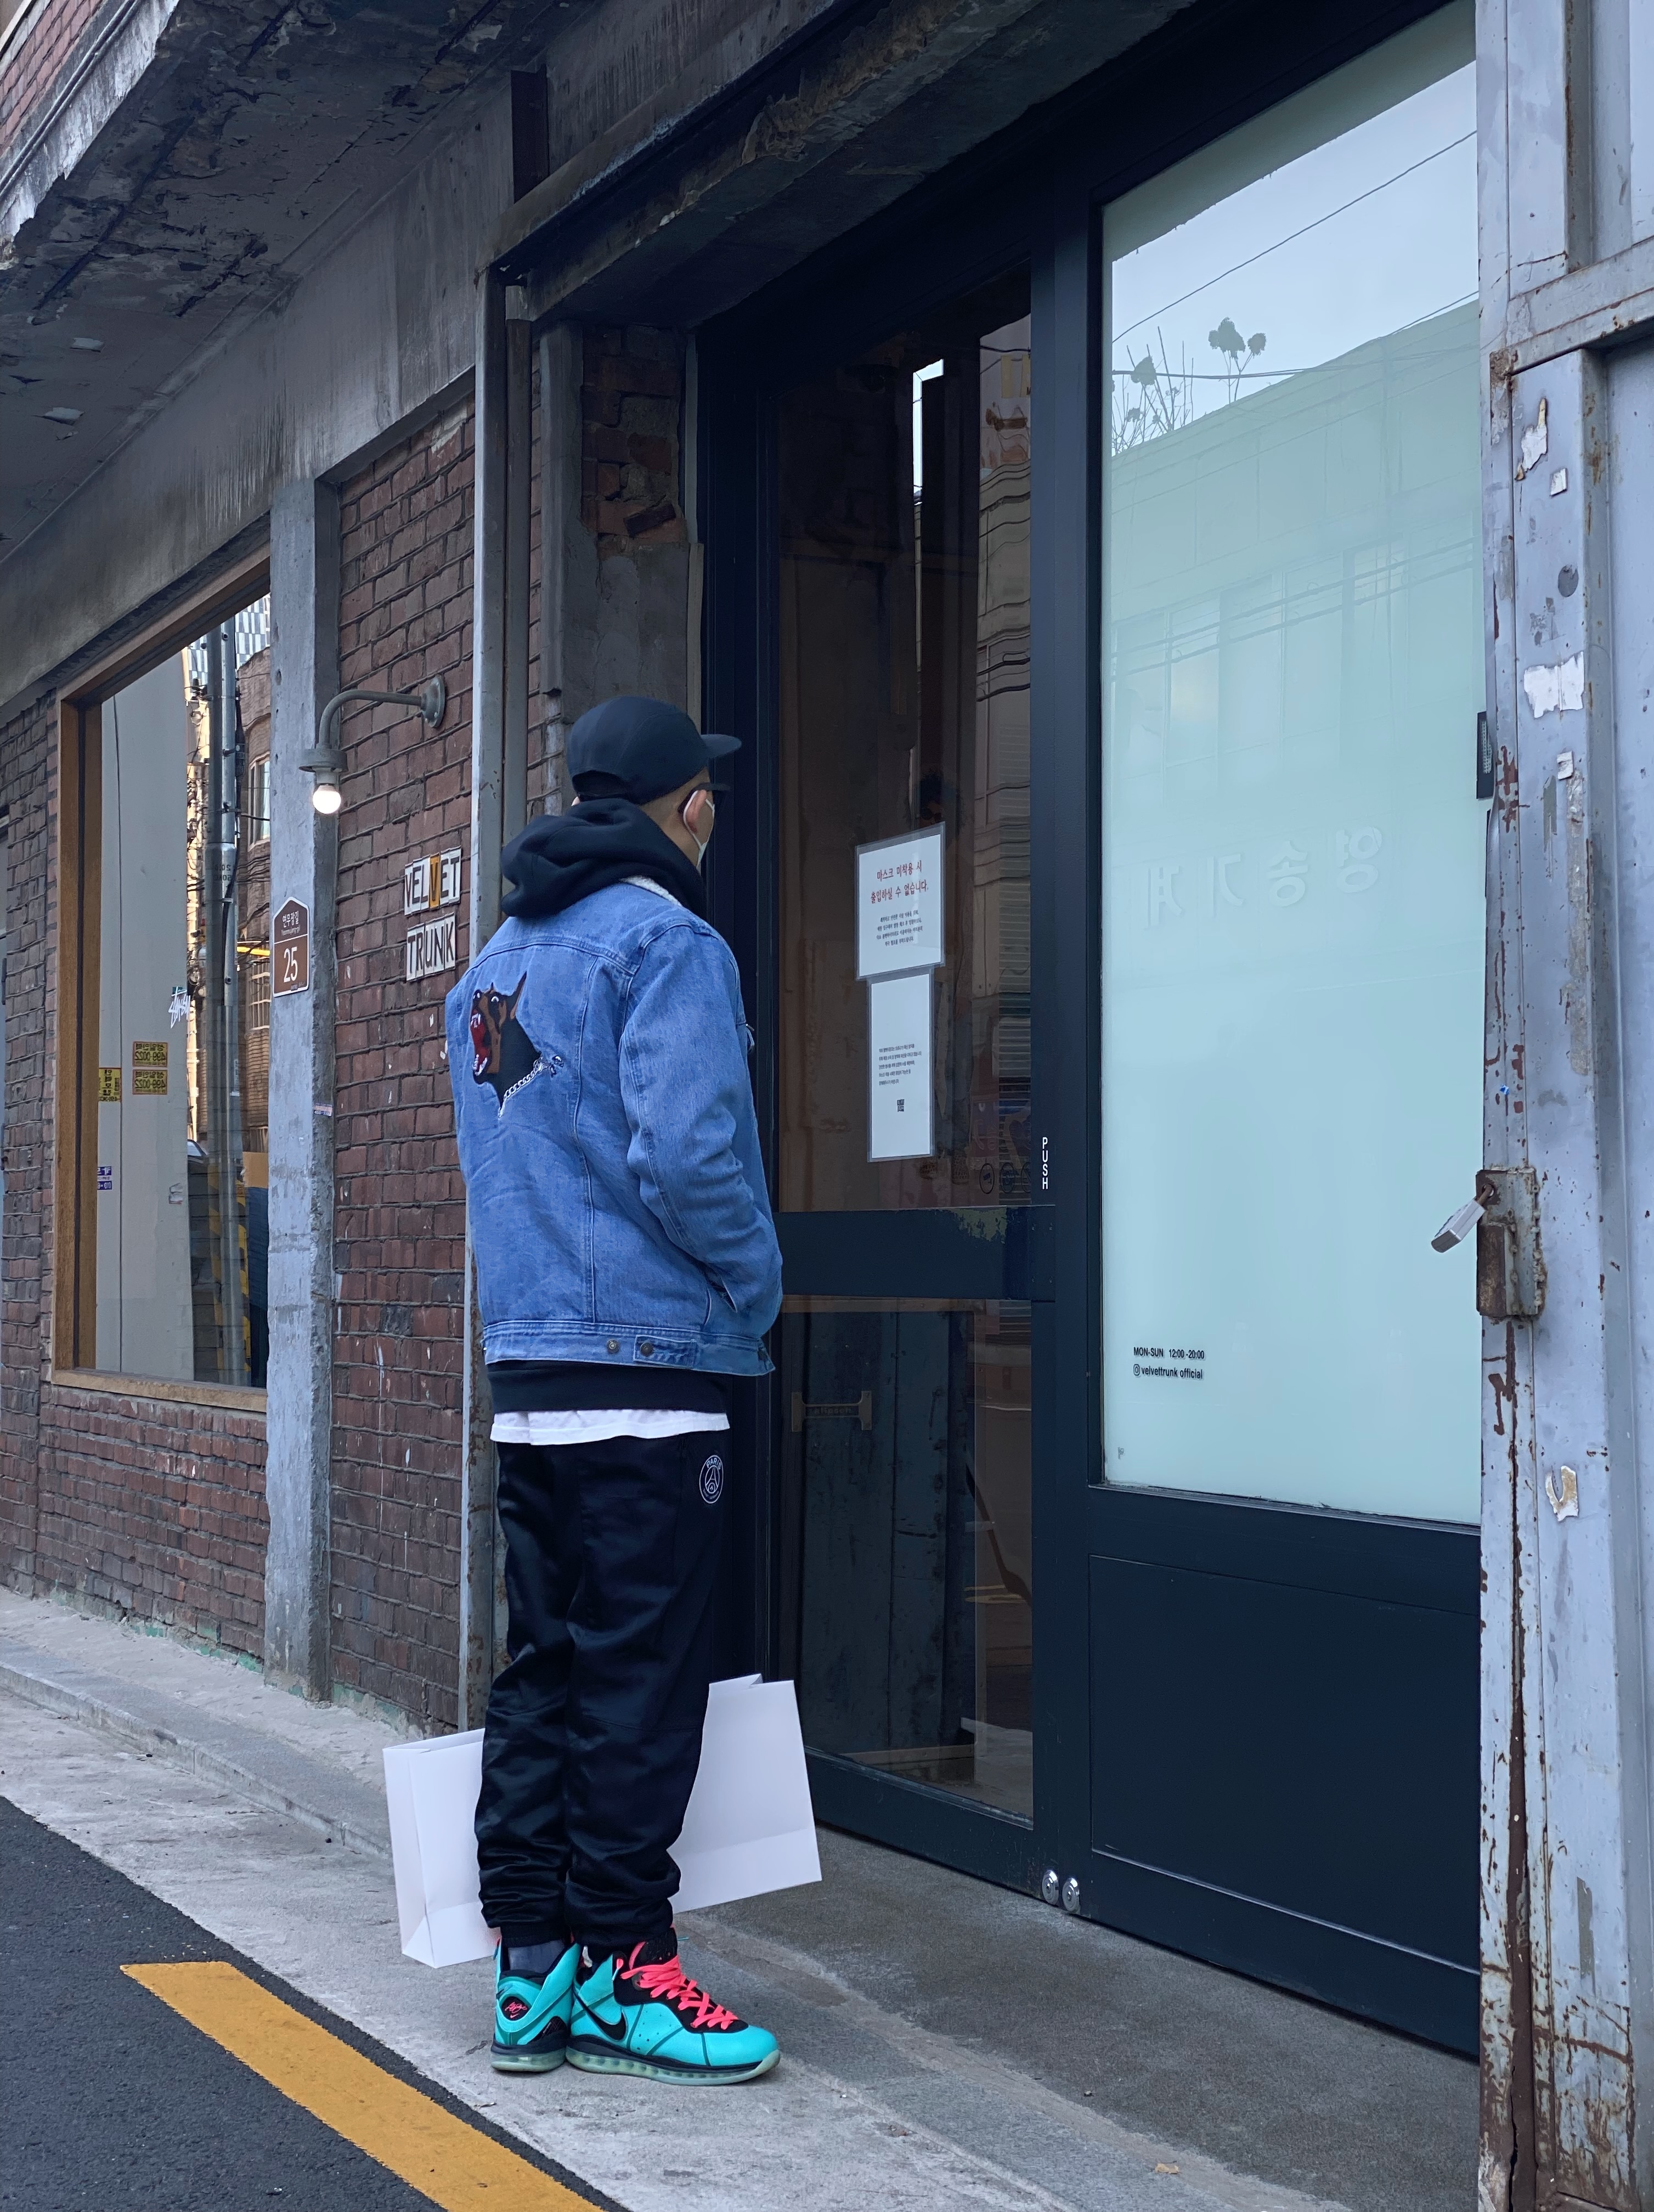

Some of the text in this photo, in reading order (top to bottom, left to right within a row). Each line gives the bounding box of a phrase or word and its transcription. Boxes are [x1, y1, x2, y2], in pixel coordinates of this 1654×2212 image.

[405, 856, 460, 908] VELVET
[877, 860, 922, 882] 마스크 미착용 시
[870, 879, 929, 904] 출입하실 수 없습니다.
[407, 926, 455, 974] TRUNK
[284, 946, 298, 983] 25
[1133, 1347, 1164, 1357] MON-SUN
[1169, 1349, 1184, 1358] 12:00
[706, 1457, 722, 1470] PARIS
